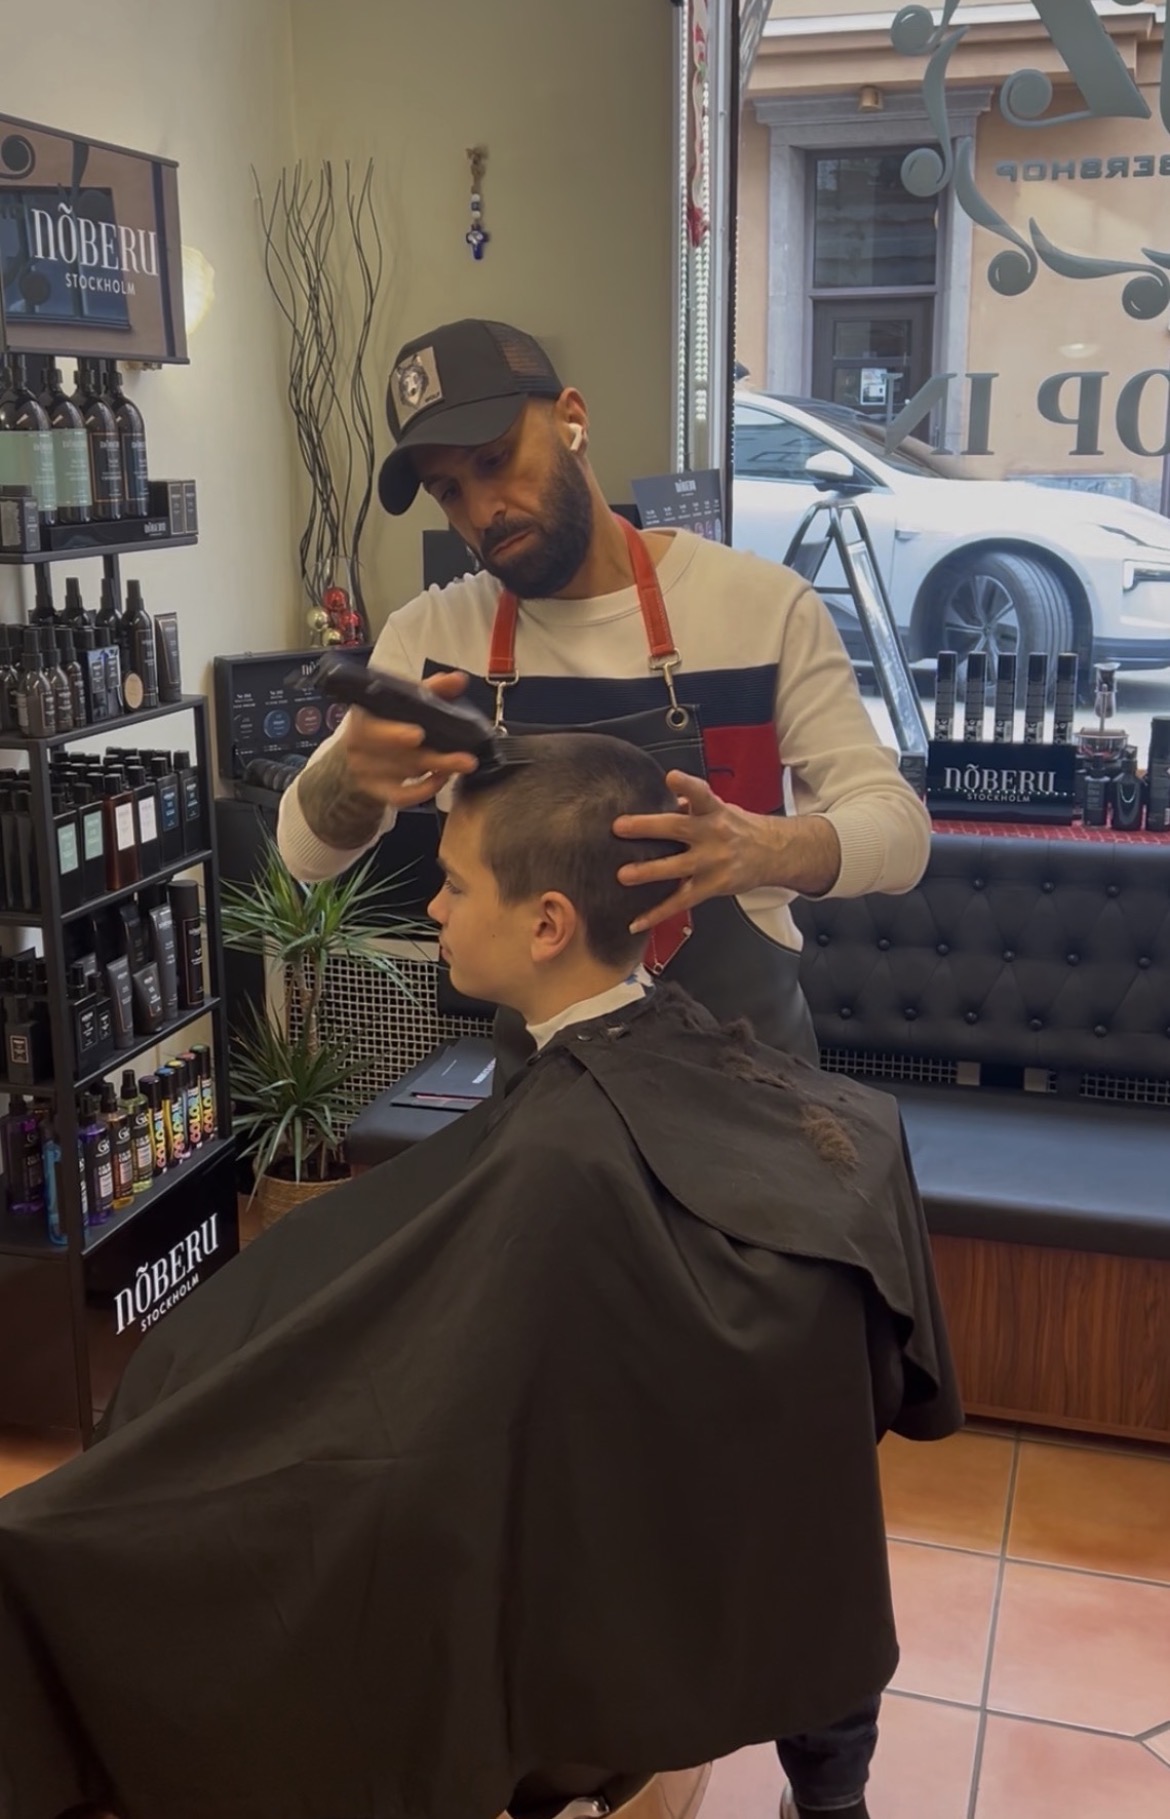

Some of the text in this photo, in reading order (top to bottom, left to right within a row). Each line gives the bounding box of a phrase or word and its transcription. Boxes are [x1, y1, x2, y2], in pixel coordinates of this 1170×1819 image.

[65, 272, 136, 296] STOCKHOLM
[967, 793, 1031, 803] STOCKHOLM
[140, 1273, 200, 1333] STOCKHOLM
